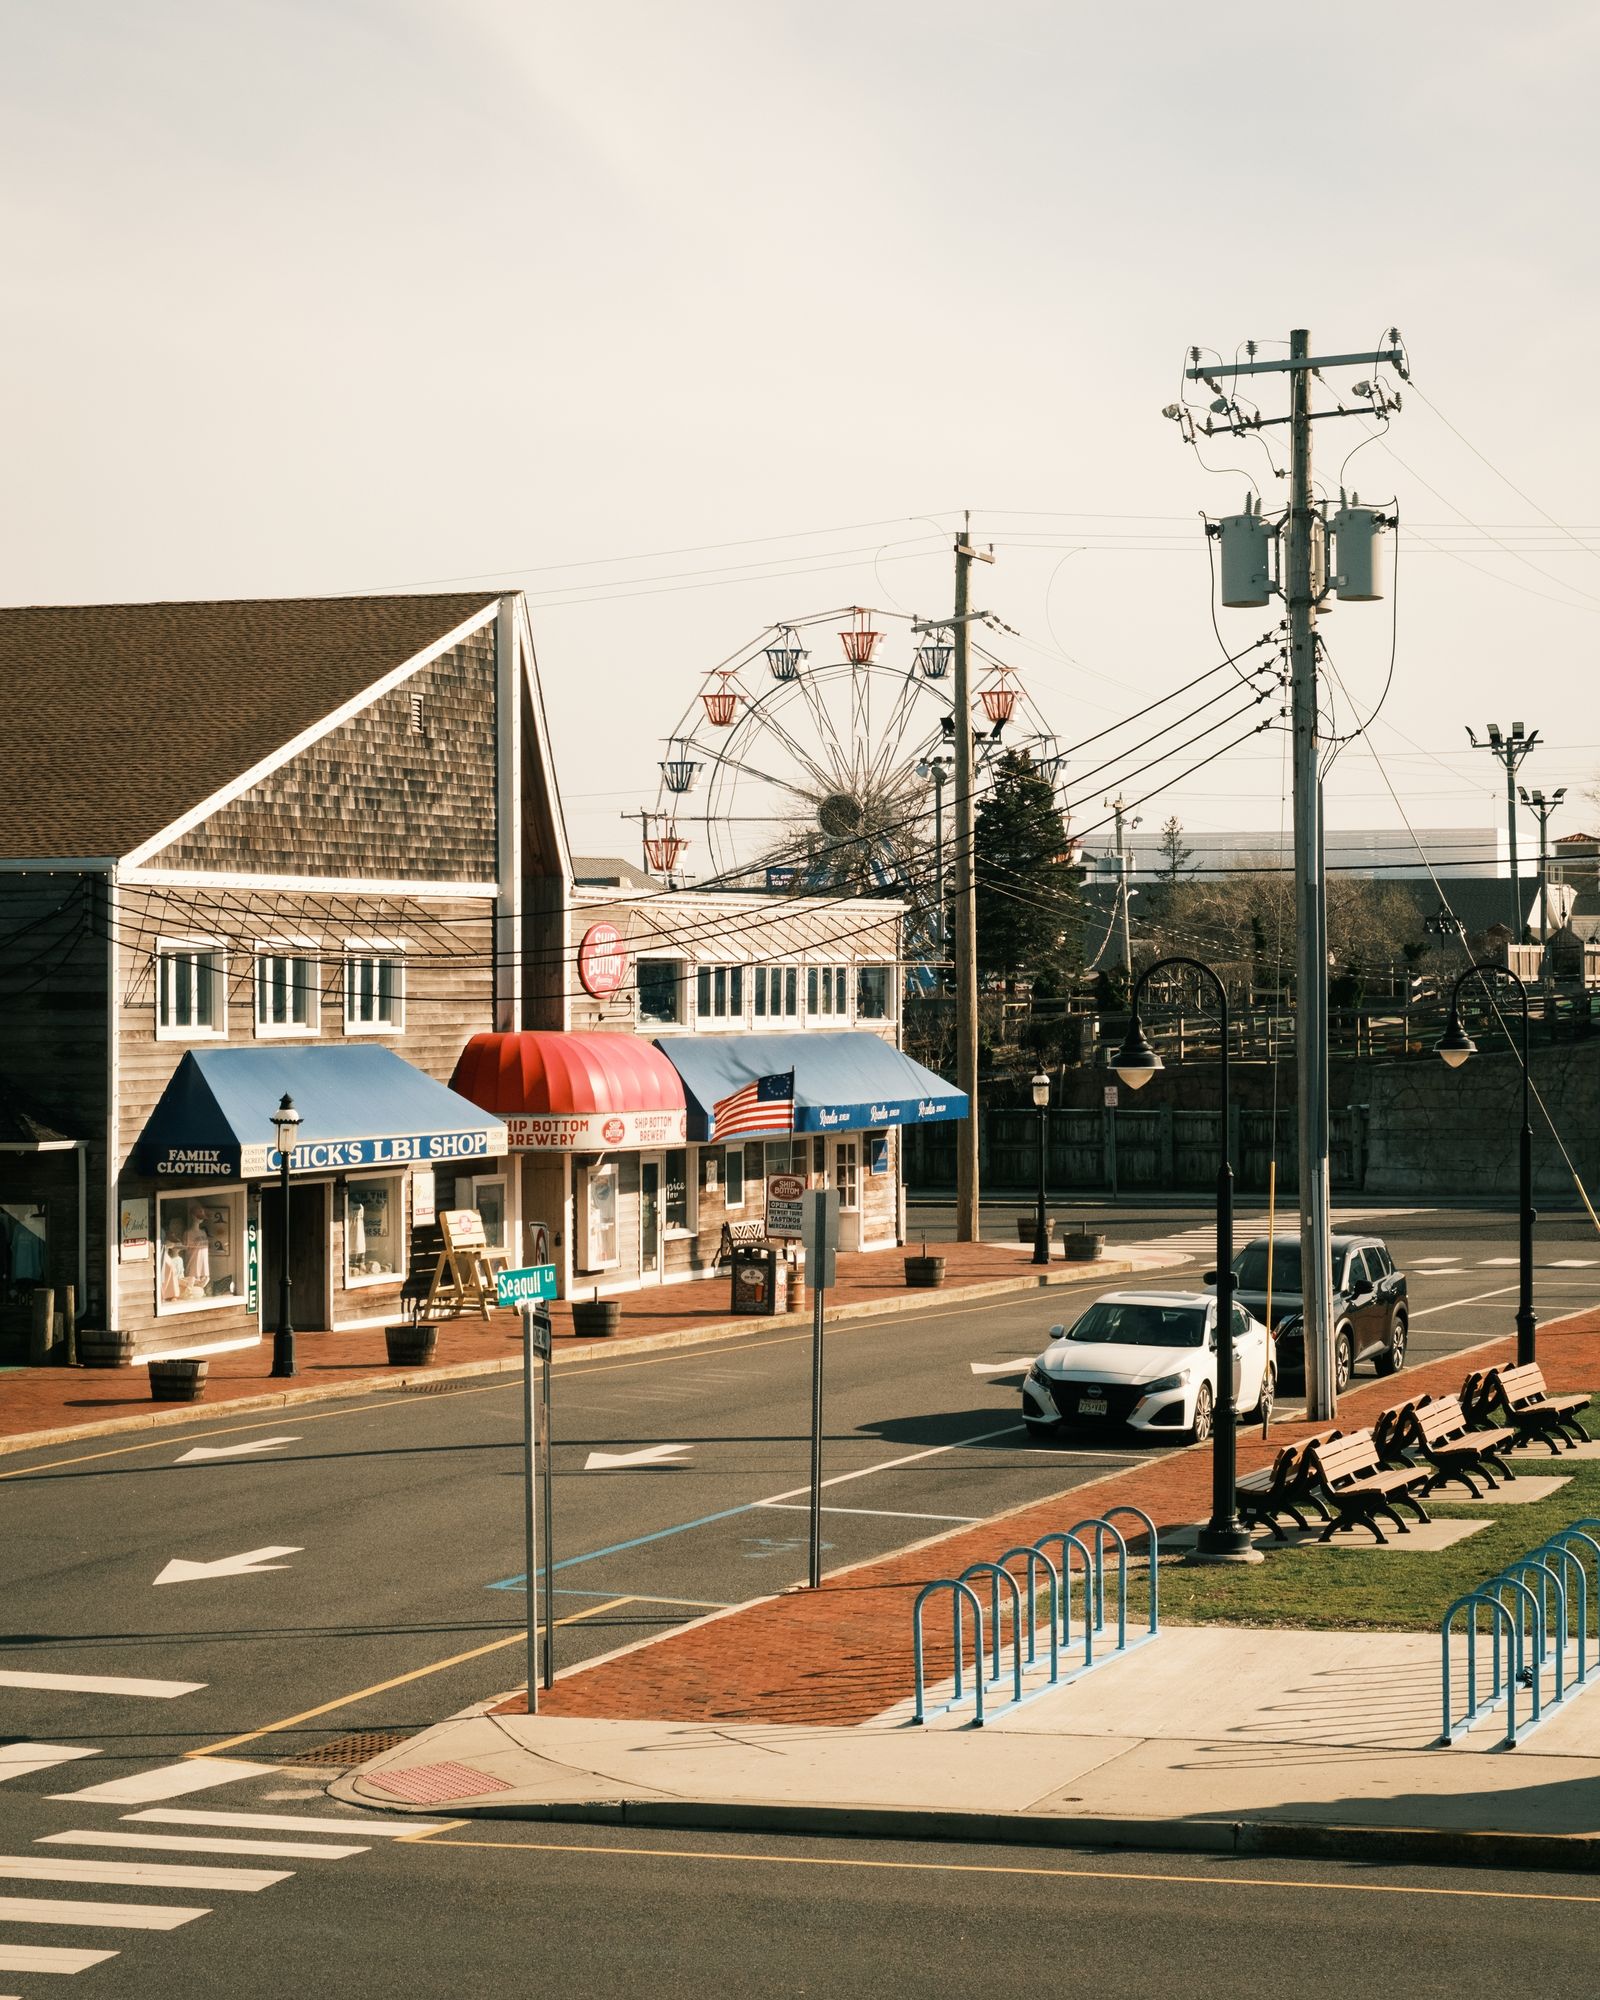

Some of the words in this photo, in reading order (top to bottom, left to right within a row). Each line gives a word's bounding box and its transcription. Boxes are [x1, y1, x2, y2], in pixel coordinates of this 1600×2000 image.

[595, 933, 616, 954] SHIP
[588, 955, 621, 976] BOTTOM
[504, 1120, 527, 1133] HIP
[532, 1120, 589, 1133] BOTTOM
[634, 1117, 648, 1129] SHIP
[649, 1115, 672, 1127] BOTTOM
[507, 1133, 576, 1146] BREWERY
[639, 1129, 667, 1142] BREWERY
[168, 1149, 220, 1161] FAMILY
[267, 1142, 363, 1170] CHICK'S
[373, 1138, 421, 1162] LBI
[429, 1133, 487, 1157] SHOP
[157, 1162, 231, 1174] CLOTHING
[779, 1180, 796, 1188] SHIP
[774, 1187, 800, 1195] BOTTOM
[248, 1224, 257, 1308] SALE
[499, 1270, 541, 1300] Seagull
[545, 1269, 554, 1282] Ln
